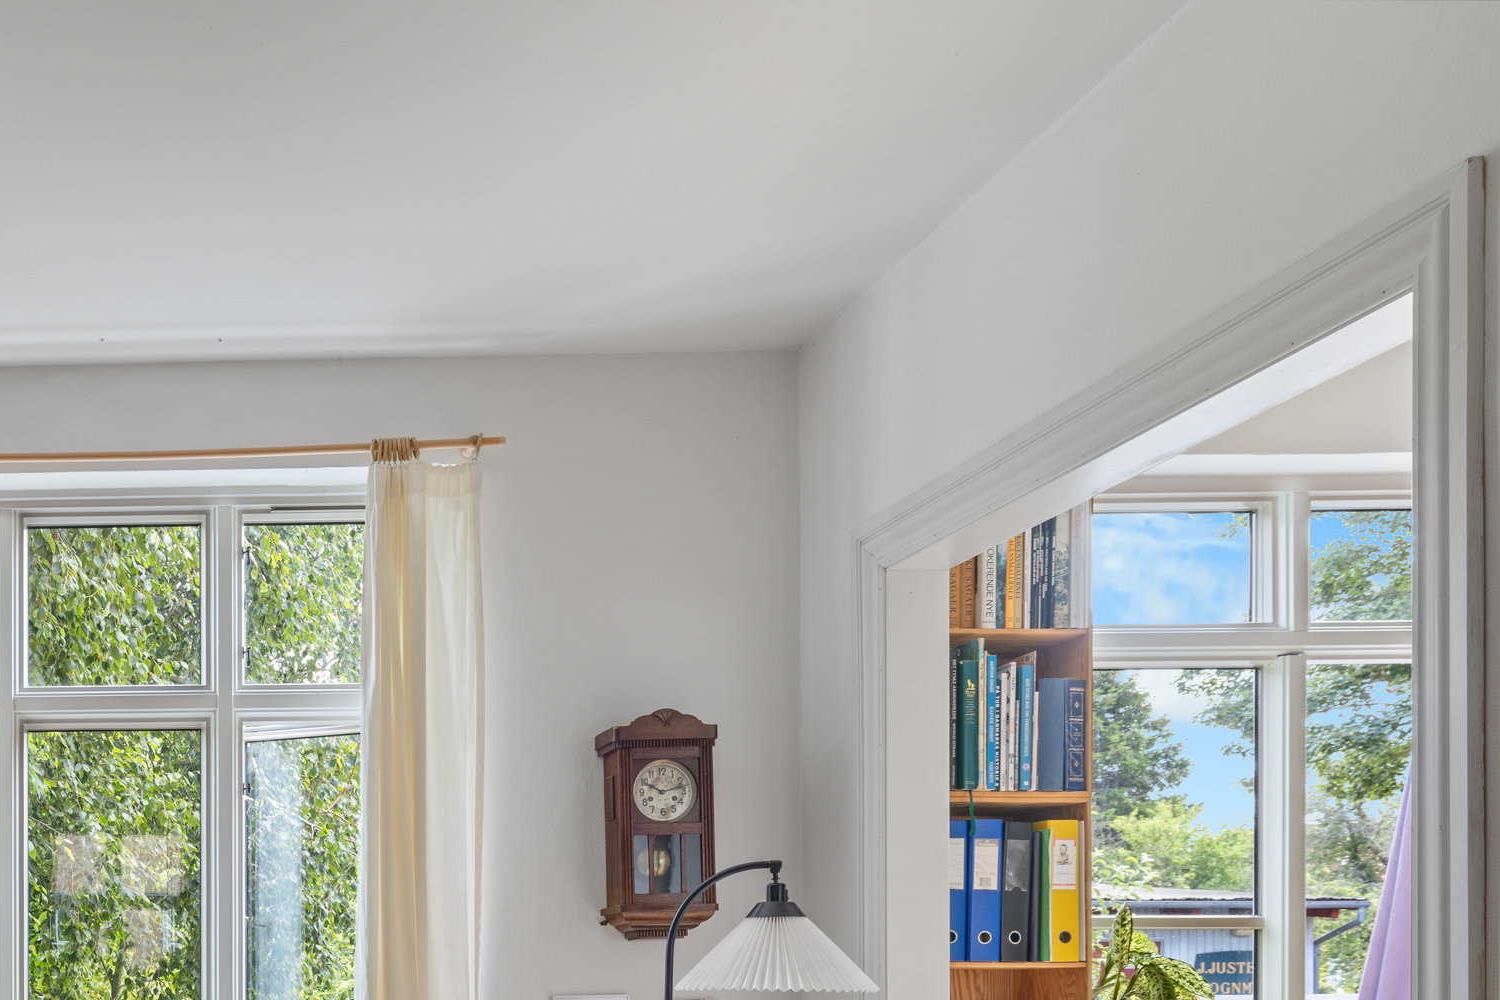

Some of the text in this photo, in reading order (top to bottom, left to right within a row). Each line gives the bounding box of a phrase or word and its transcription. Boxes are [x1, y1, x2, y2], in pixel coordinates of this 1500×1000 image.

[986, 546, 994, 618] OKERENDE NYE
[964, 576, 972, 617] SAGAER
[648, 770, 655, 778] 11
[658, 767, 667, 776] 12
[641, 778, 649, 786] 10
